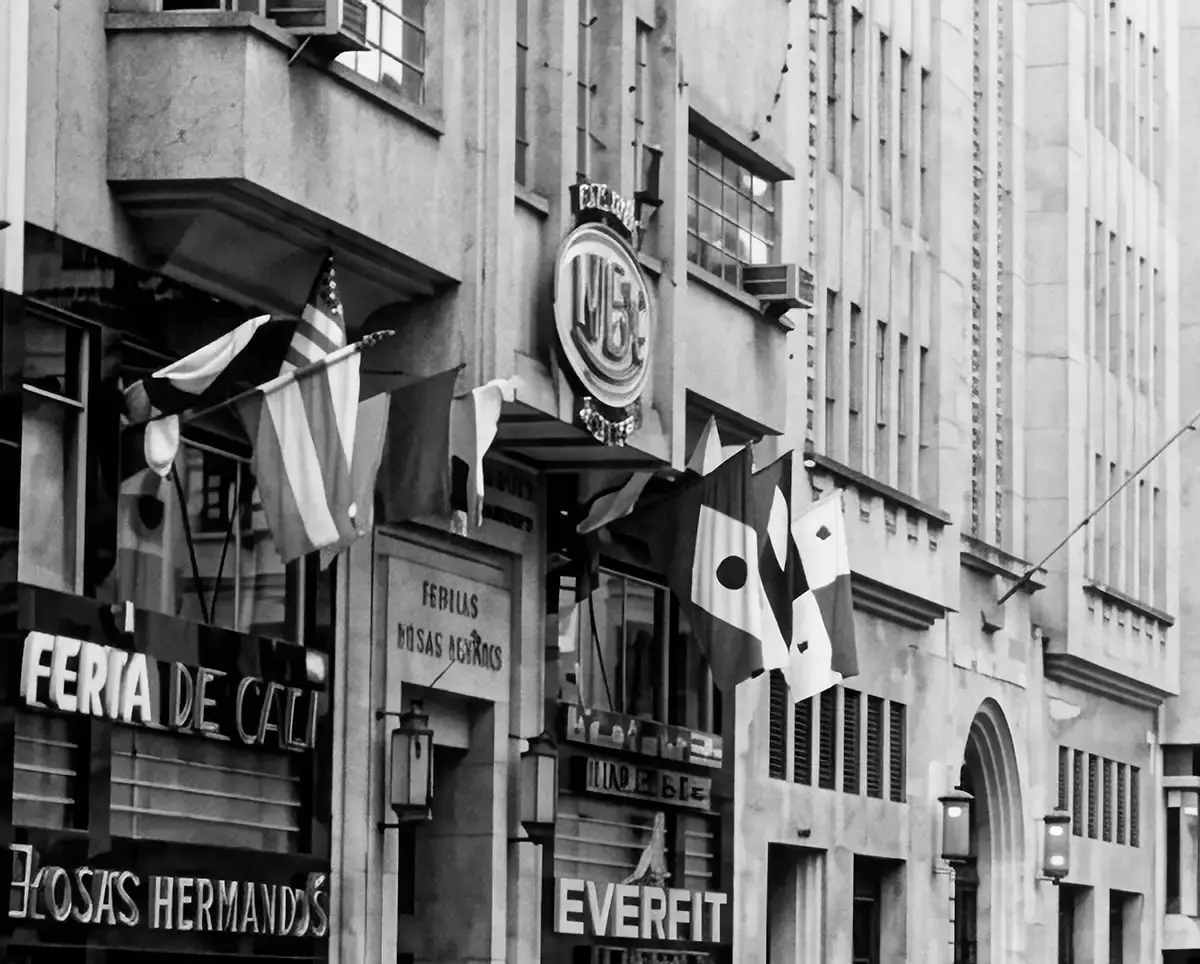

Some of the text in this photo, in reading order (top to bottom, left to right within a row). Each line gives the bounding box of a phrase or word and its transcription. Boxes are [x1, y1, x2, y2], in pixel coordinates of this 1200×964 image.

[20, 630, 157, 728] FERIA
[169, 661, 231, 740] DE
[554, 877, 728, 942] EVERFIT
